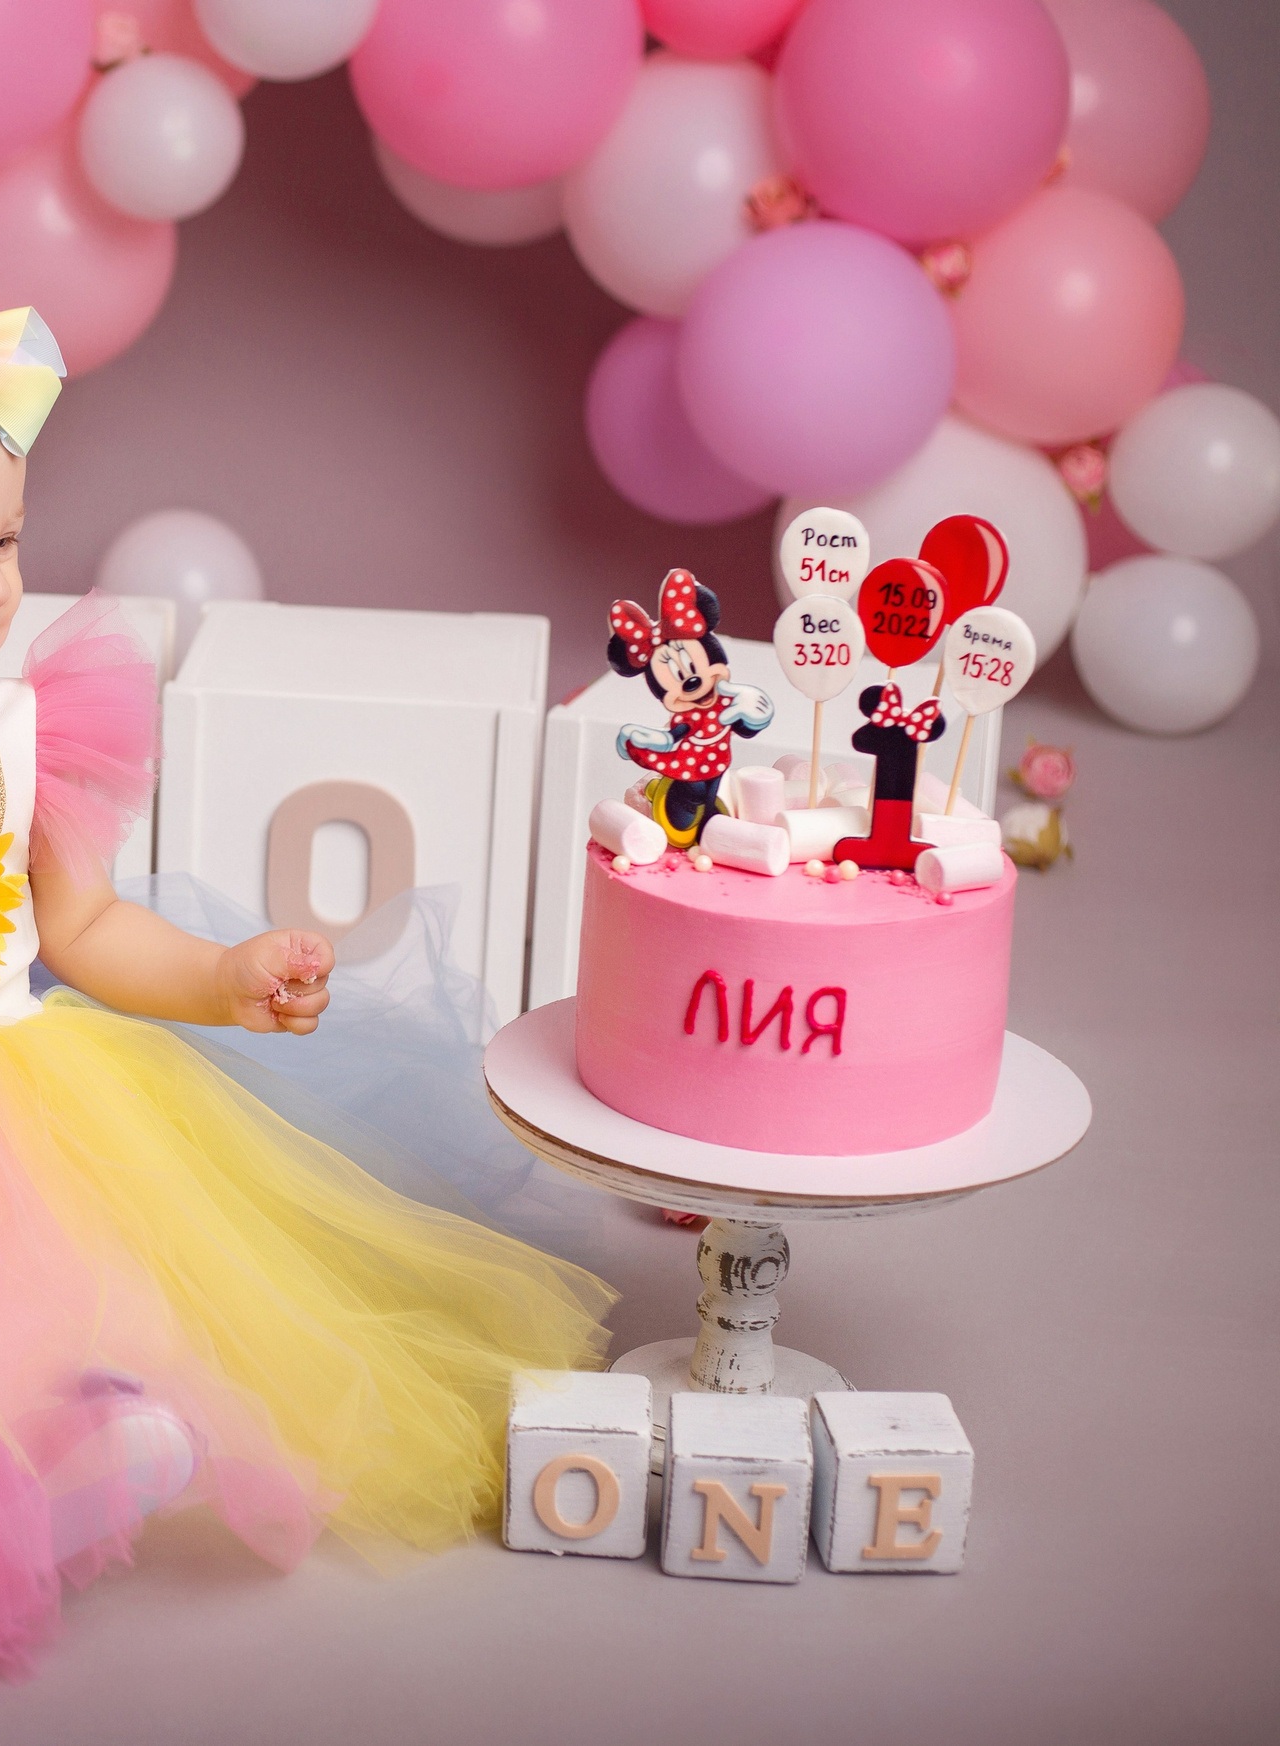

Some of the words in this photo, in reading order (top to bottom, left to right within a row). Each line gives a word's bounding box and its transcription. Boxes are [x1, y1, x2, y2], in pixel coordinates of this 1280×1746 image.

[801, 527, 858, 548] Рост
[879, 582, 938, 610] 15.09
[800, 613, 841, 634] Вес
[872, 611, 931, 638] 2022
[963, 624, 1013, 651] Время
[794, 643, 851, 666] 3320
[958, 652, 1015, 686] 15:28
[684, 969, 847, 1056] ЛИЯ
[533, 1453, 944, 1566] ONE
